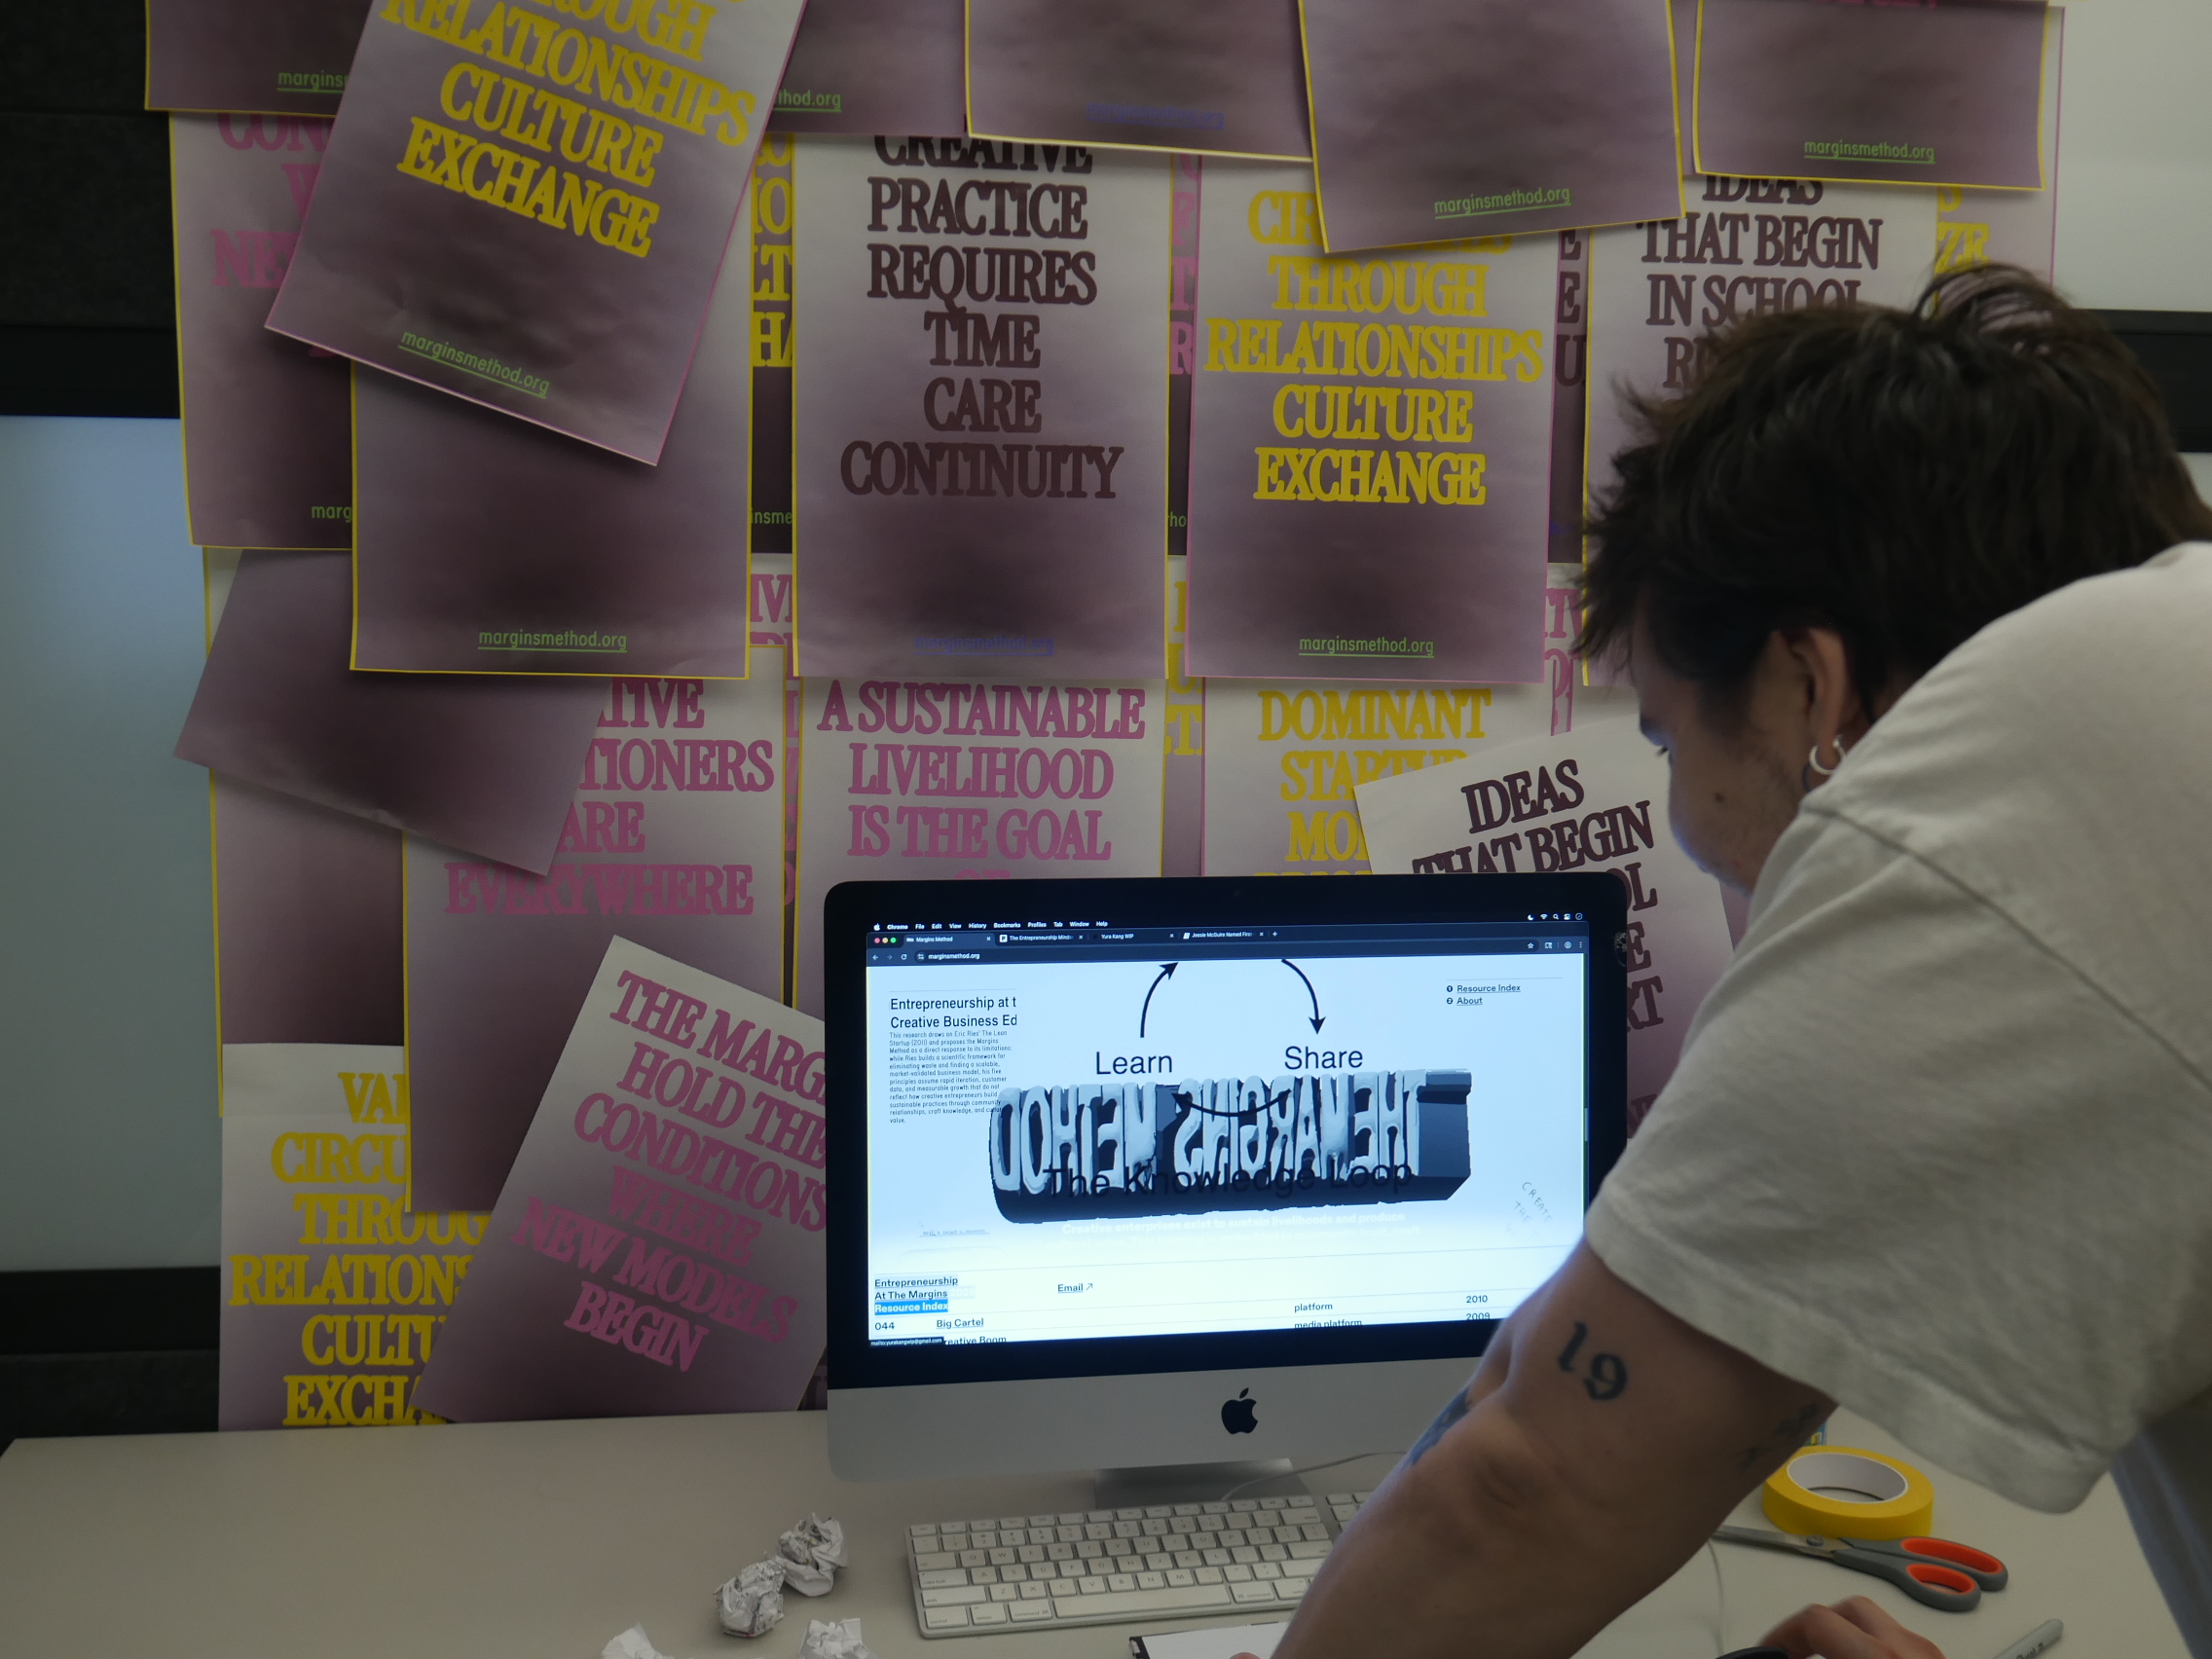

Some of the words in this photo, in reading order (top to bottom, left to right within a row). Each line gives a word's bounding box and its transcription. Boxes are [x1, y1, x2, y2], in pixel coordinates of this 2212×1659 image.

[440, 60, 664, 187] CULTURE
[1804, 139, 1936, 164] marginsmethod.org
[396, 115, 660, 257] EXCHANGE
[867, 176, 1088, 239] PRACTICE
[1435, 187, 1572, 214] marginsmethod.org
[1753, 214, 1883, 270] BEGIN
[867, 243, 1097, 313] REQUIRES
[1268, 255, 1489, 316] THROUGH
[1646, 274, 1696, 326] IN
[401, 330, 550, 395] marginsmethod.org
[924, 310, 1041, 368] TIME
[1204, 317, 1543, 382] RELATIONSHIPS
[924, 377, 1042, 432] CARE
[1273, 384, 1473, 442] CULTURE
[840, 440, 1124, 498] CONTINUITY
[1254, 447, 1486, 505] EXCHANGE
[478, 628, 628, 649] marginsmethod.org
[1300, 635, 1434, 655] marginsmethod.org
[816, 680, 853, 731] A
[858, 681, 1145, 739] SUSTAINABLE
[1258, 688, 1492, 741] DOMINANT
[848, 742, 1114, 799] LIVELIHOOD
[1461, 759, 1584, 833] IDEAS
[847, 804, 890, 857] IS
[897, 805, 988, 859] THE
[996, 808, 1112, 861] GOAL
[1525, 800, 1654, 874] BEGIN
[443, 863, 754, 915] EVERYWHERE
[609, 970, 708, 1049] THE
[891, 996, 994, 1012] Entrepreneurship
[998, 997, 1009, 1008] at
[1013, 997, 1016, 1007] t
[891, 1015, 940, 1028] Creative
[943, 1014, 998, 1027] Business
[1003, 1014, 1017, 1025] Ed
[1096, 1051, 1172, 1075] Learn
[1285, 1046, 1363, 1070] Share
[616, 1041, 746, 1128] HOLD
[745, 1091, 827, 1168] THE
[574, 1092, 827, 1232] CONDITIONS
[1044, 1167, 1110, 1199] The
[1124, 1161, 1314, 1198] Knowledge
[1330, 1159, 1413, 1193] Loop
[607, 1165, 762, 1266] WHERE
[510, 1196, 628, 1275] NEW
[612, 1235, 797, 1343] MODELS
[874, 1276, 958, 1288] Entrepreneurship
[875, 1291, 886, 1300] At
[909, 1290, 947, 1301] Margins
[1057, 1283, 1084, 1292] Email
[564, 1280, 709, 1372] BEGIN
[876, 1304, 920, 1312] Resource
[937, 1319, 951, 1329] Big
[954, 1318, 983, 1327] Cartel
[1295, 1303, 1333, 1312] platform
[1466, 1295, 1488, 1304] 2010
[1558, 1322, 1627, 1400] 19
